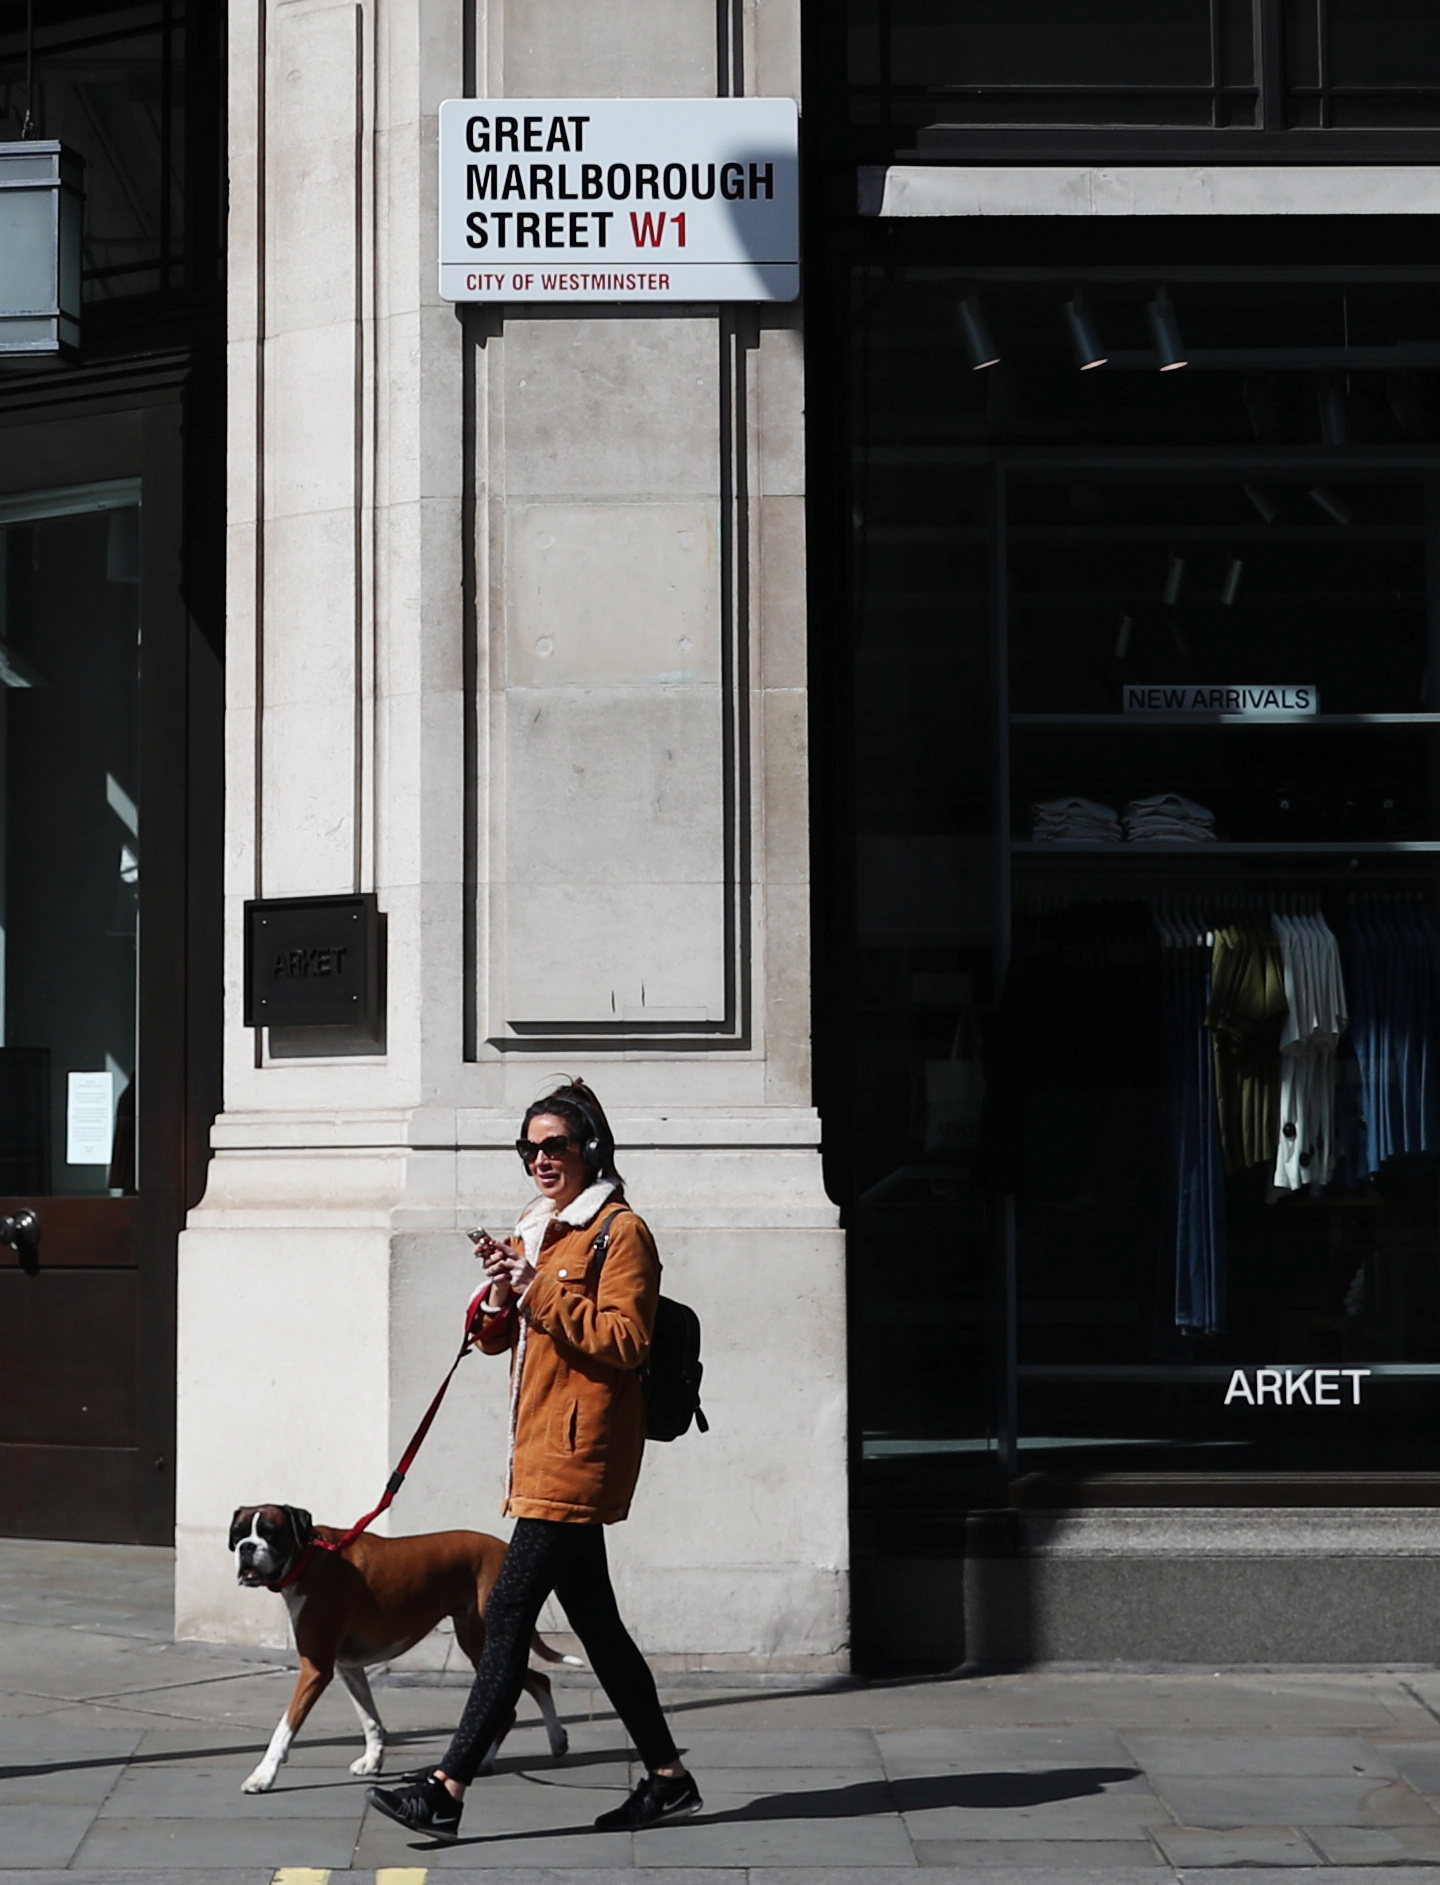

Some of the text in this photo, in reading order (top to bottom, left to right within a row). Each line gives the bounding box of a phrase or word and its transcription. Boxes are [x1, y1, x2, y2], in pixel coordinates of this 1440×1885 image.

[466, 116, 590, 152] GREAT
[466, 163, 774, 200] MARLBOROUGH
[466, 211, 686, 248] STREET W1
[466, 274, 670, 290] CITY OF WESTMINSTER
[1128, 689, 1309, 709] NEW ARRIVALS
[274, 946, 347, 979] ARKET
[1223, 1369, 1371, 1405] ARKET
